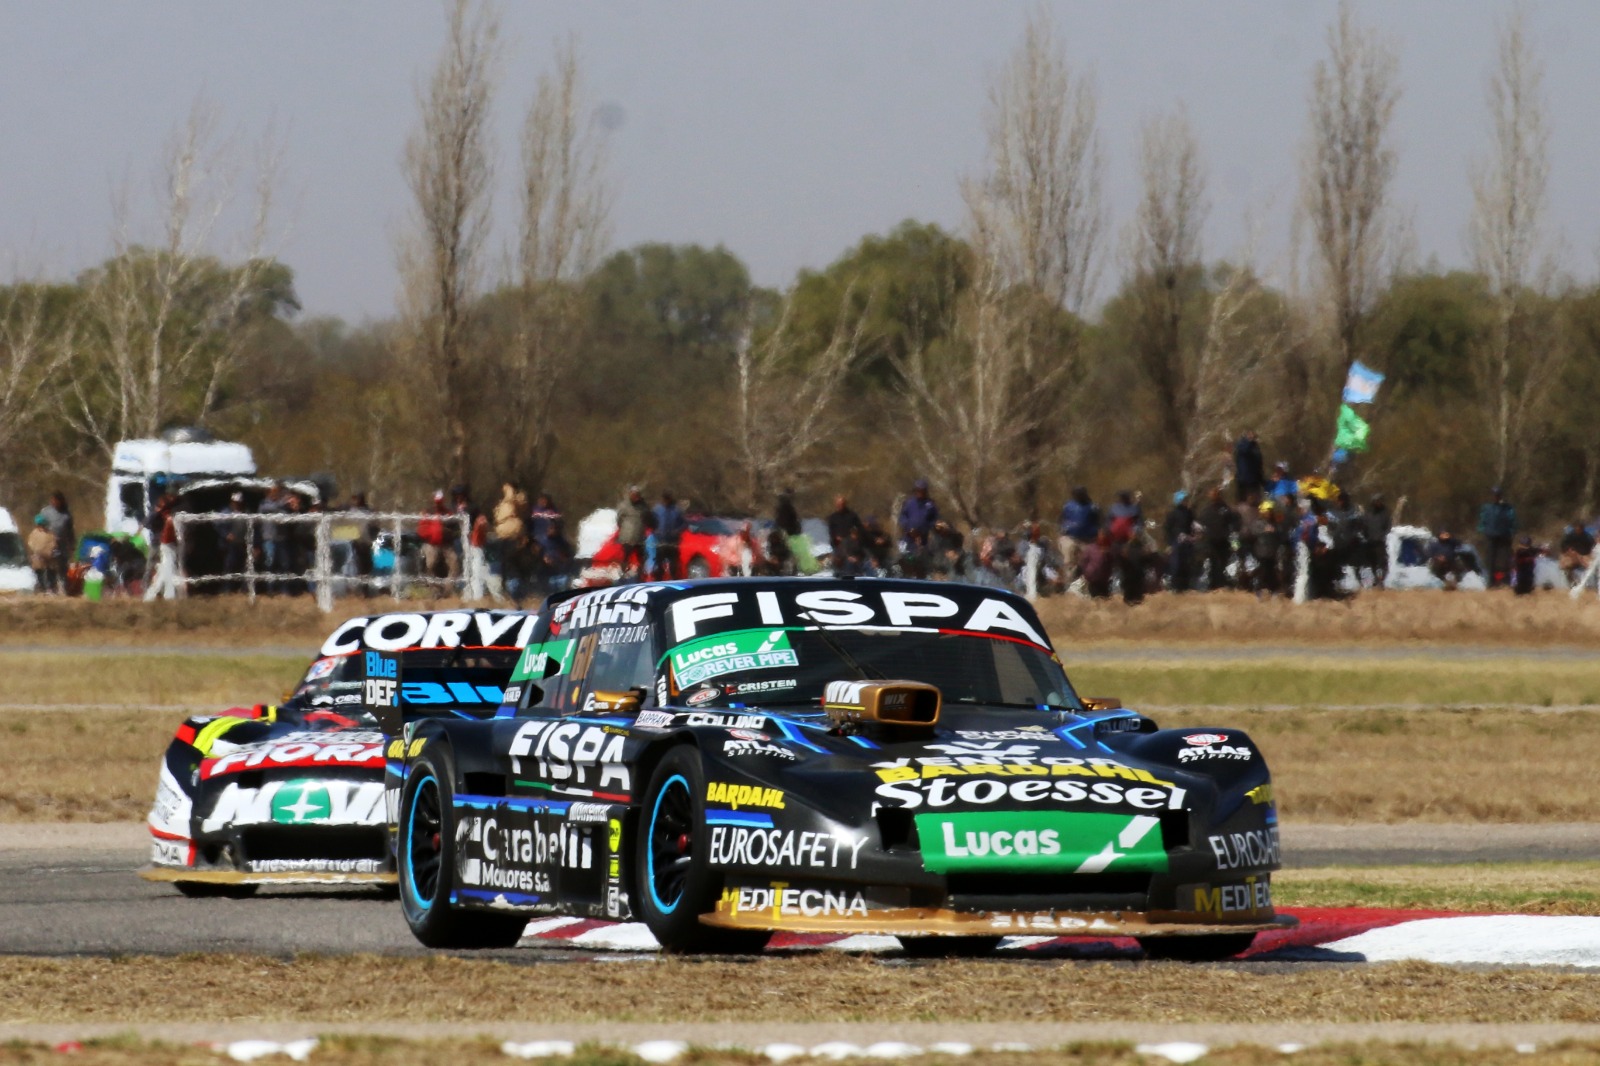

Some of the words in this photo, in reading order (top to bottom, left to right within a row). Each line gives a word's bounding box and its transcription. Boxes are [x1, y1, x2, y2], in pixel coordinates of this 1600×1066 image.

[570, 586, 664, 629] ATLAS
[673, 590, 1051, 649] FISPA
[599, 625, 649, 645] SHIPPING
[365, 651, 397, 678] Blue
[523, 648, 548, 674] Lucas
[676, 642, 738, 669] Lucas
[759, 652, 792, 666] PIPE
[366, 680, 397, 705] DEF
[738, 679, 797, 692] CRISTEM
[885, 693, 908, 705] WIX
[509, 720, 631, 790] FISPA
[723, 740, 795, 757] ATLAS
[1178, 745, 1252, 759] ATLAS
[1181, 753, 1251, 763] SHIPPING
[875, 764, 1176, 787] BARDAHL
[706, 782, 786, 811] BARDAHL
[875, 777, 1187, 811] Stoessel
[709, 827, 870, 870] EUROSAFETY
[942, 822, 1061, 857] Lucas
[718, 881, 869, 921] MEDITECNA
